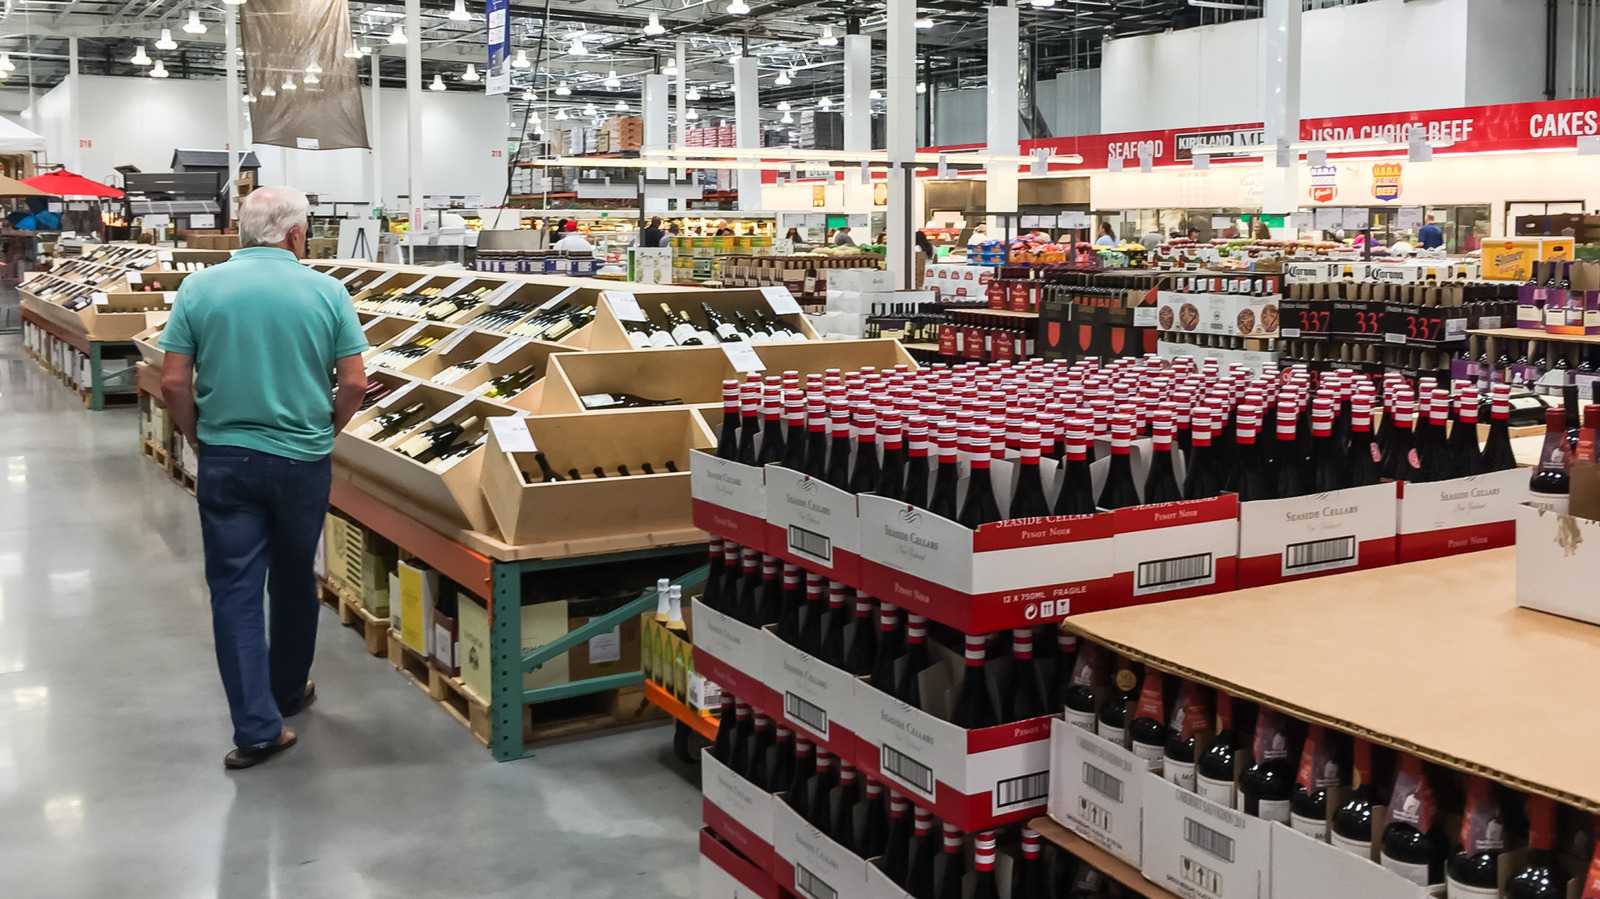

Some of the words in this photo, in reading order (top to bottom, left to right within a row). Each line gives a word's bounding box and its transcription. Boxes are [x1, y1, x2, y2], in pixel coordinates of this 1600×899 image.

[1360, 122, 1423, 144] CHOIC
[1428, 119, 1473, 143] BEEF
[1529, 110, 1598, 138] CAKES
[1178, 134, 1231, 150] KIRKLAND
[1288, 265, 1317, 278] Corona
[1371, 267, 1404, 280] Corona
[1299, 310, 1331, 332] 337
[1355, 312, 1384, 334] 33
[1406, 316, 1441, 341] 337
[1440, 491, 1469, 502] SEASIDE
[1471, 487, 1501, 498] CELLARS
[996, 516, 1042, 529] SEASIDE
[1045, 513, 1094, 524] CELLARS
[1154, 511, 1177, 522] PINOT
[1179, 509, 1198, 518] NOIR
[1285, 510, 1320, 522] SEASIDE
[1322, 505, 1358, 517] CELLARS
[884, 524, 908, 542] SEASIDE
[910, 532, 939, 550] CELLARS
[1021, 529, 1046, 540] PINOT
[1049, 527, 1072, 537] NOIR
[894, 582, 913, 597] PINOT
[913, 587, 930, 603] NOIR
[1003, 595, 1011, 604] 12
[1012, 594, 1019, 602] X
[1021, 591, 1046, 602] 750ML
[1053, 585, 1087, 597] FRAGILE
[906, 722, 934, 745] CELLARS
[1014, 726, 1040, 738] PINOT
